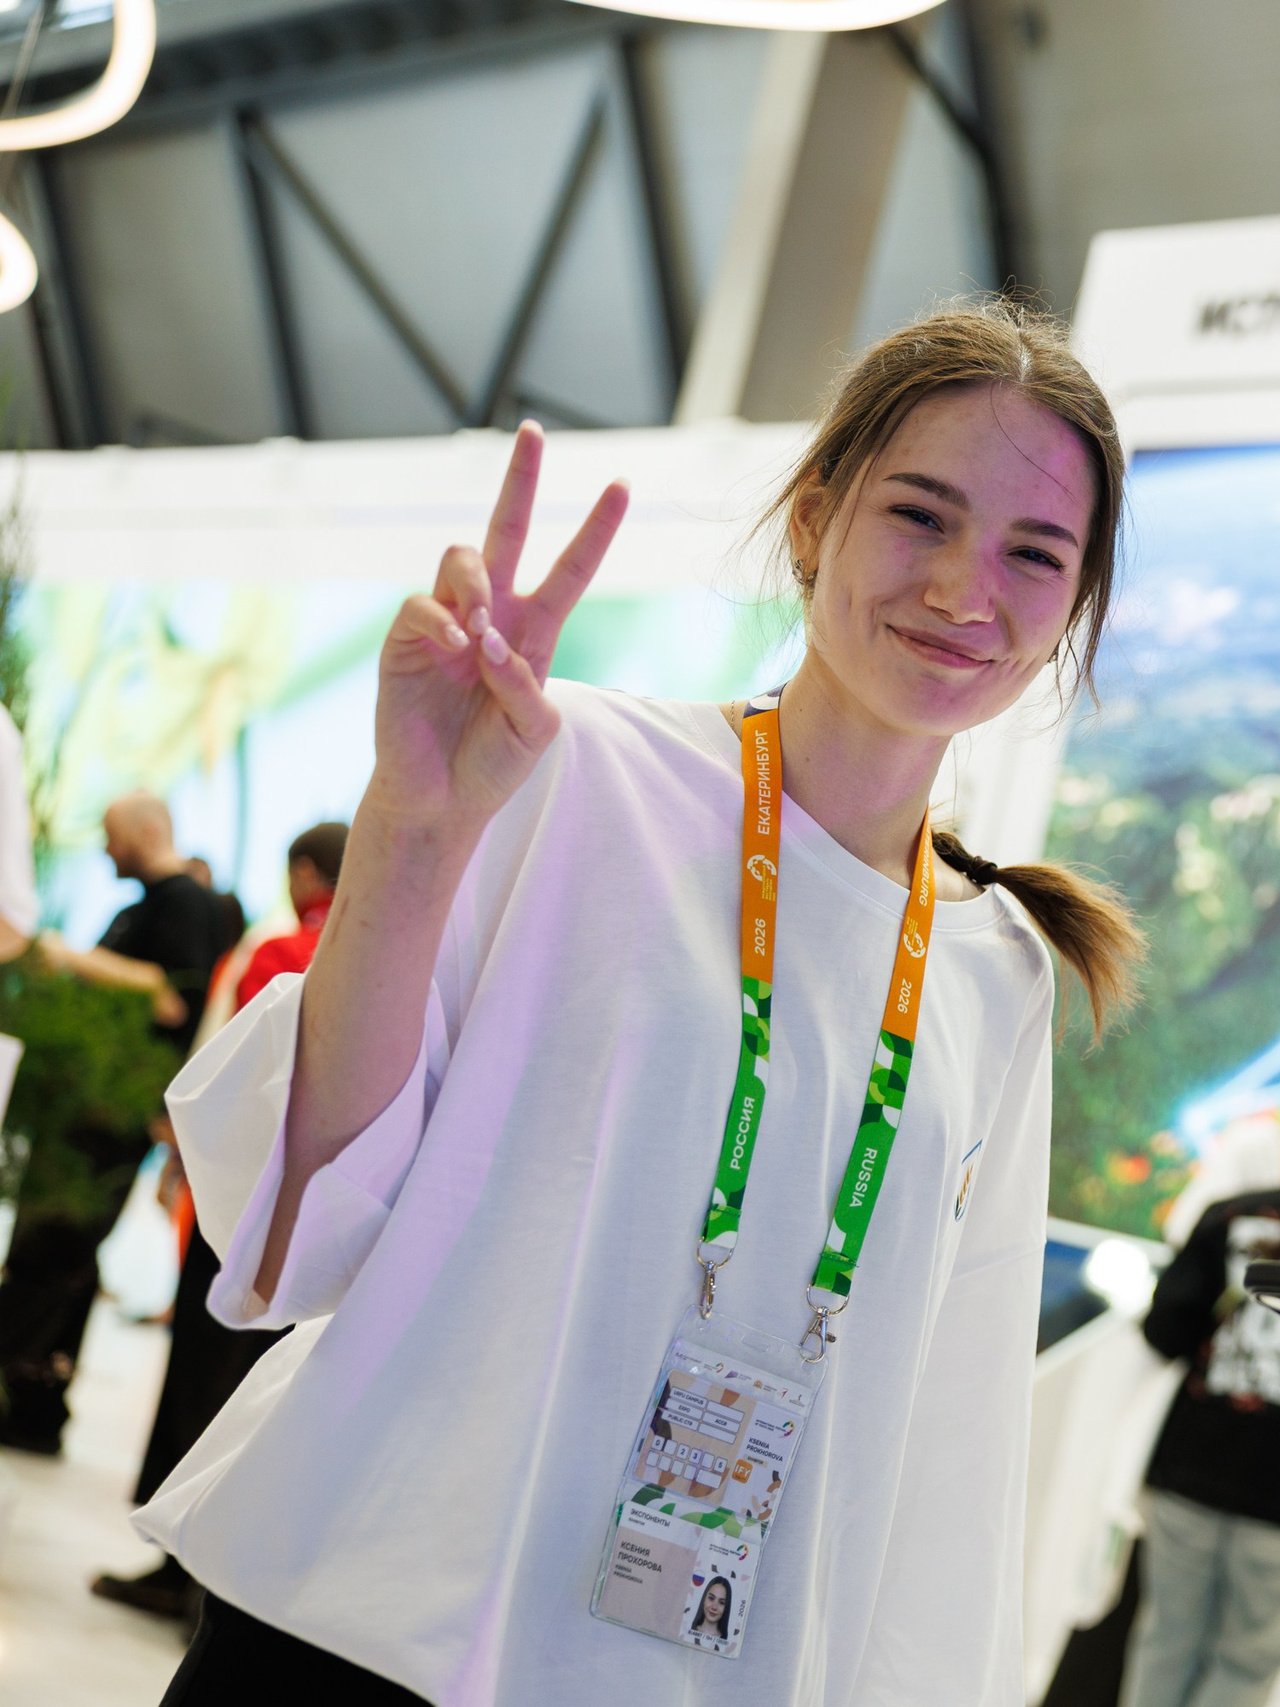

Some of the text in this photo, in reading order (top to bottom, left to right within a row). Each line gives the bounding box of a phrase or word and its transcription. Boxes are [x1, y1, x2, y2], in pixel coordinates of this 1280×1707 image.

[754, 729, 771, 836] ЕКАТЕРИНБУРГ
[754, 917, 766, 957] 2026
[897, 978, 913, 1014] 2026
[730, 1096, 756, 1171] РОССИЯ
[849, 1147, 879, 1209] RUSSIA
[678, 1405, 691, 1413] EXPO
[734, 1464, 751, 1477] IFY
[630, 1508, 671, 1527] ЭКСПОНЕНТЫ
[620, 1540, 651, 1557] КСЕНИЯ
[617, 1551, 662, 1573] ПРОХОРОВА
[738, 1600, 747, 1617] 2026
